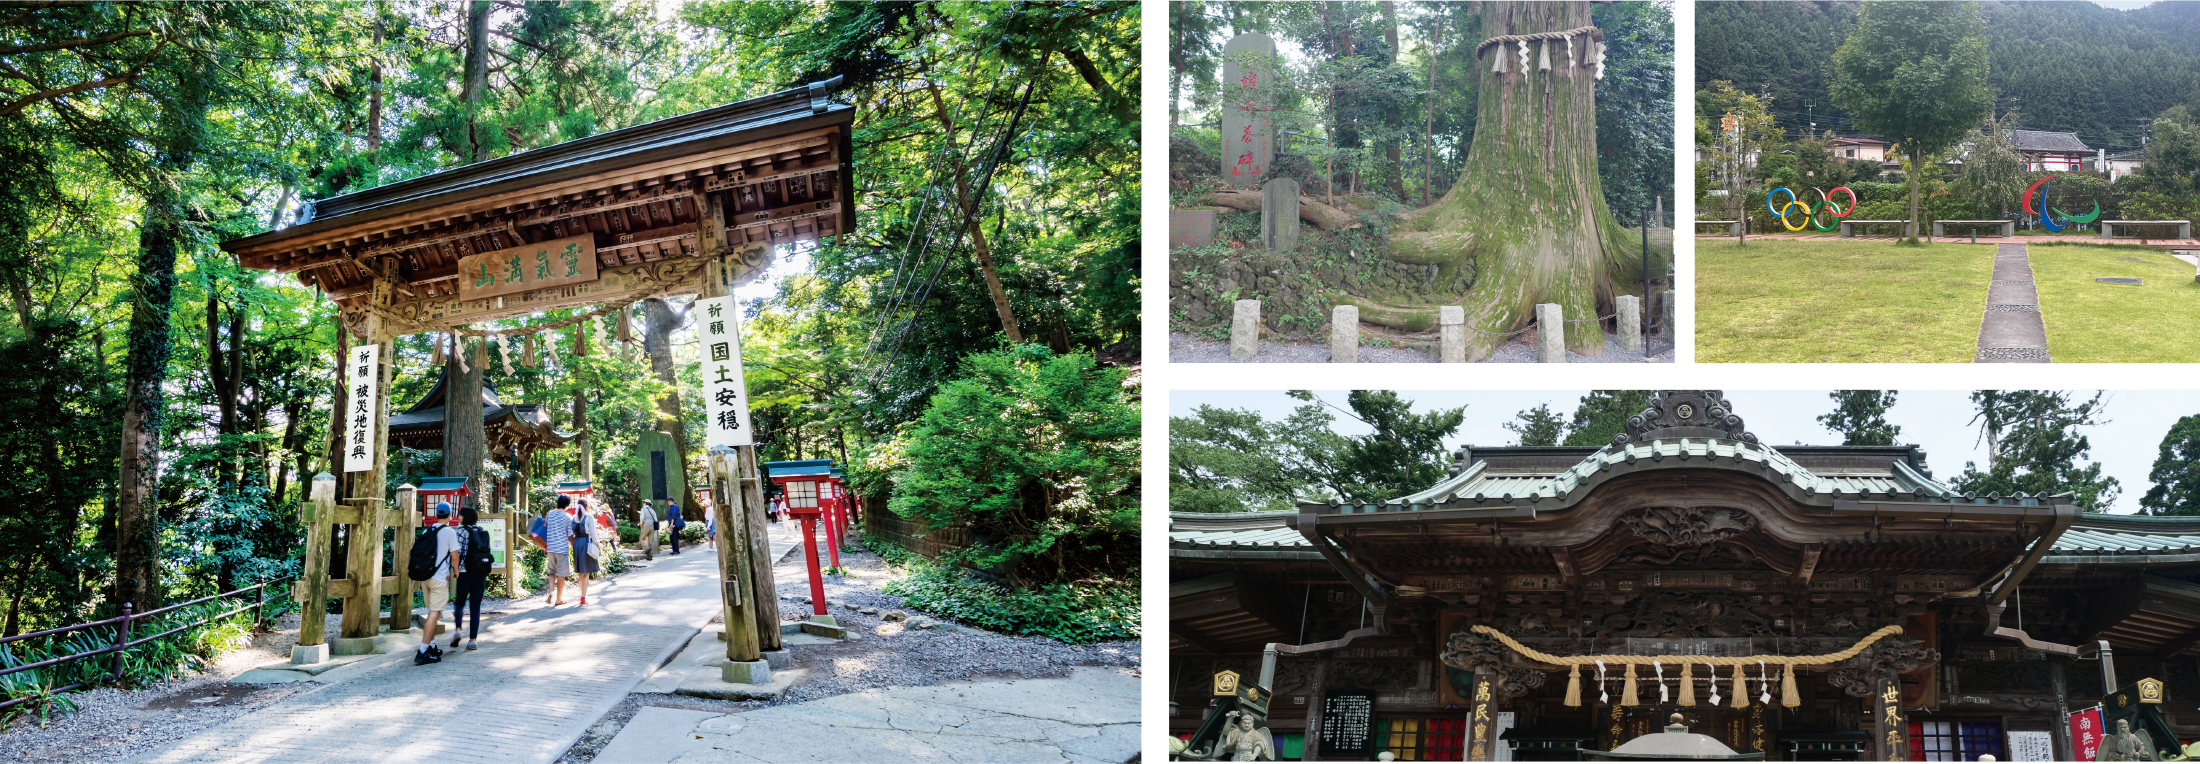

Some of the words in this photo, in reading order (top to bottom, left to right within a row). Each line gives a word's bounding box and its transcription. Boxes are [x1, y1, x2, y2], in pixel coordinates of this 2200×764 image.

[707, 302, 725, 335] 祈願
[357, 350, 370, 377] 祈願
[351, 383, 369, 459] 被災地復興
[2079, 716, 2096, 762] 南無飯
